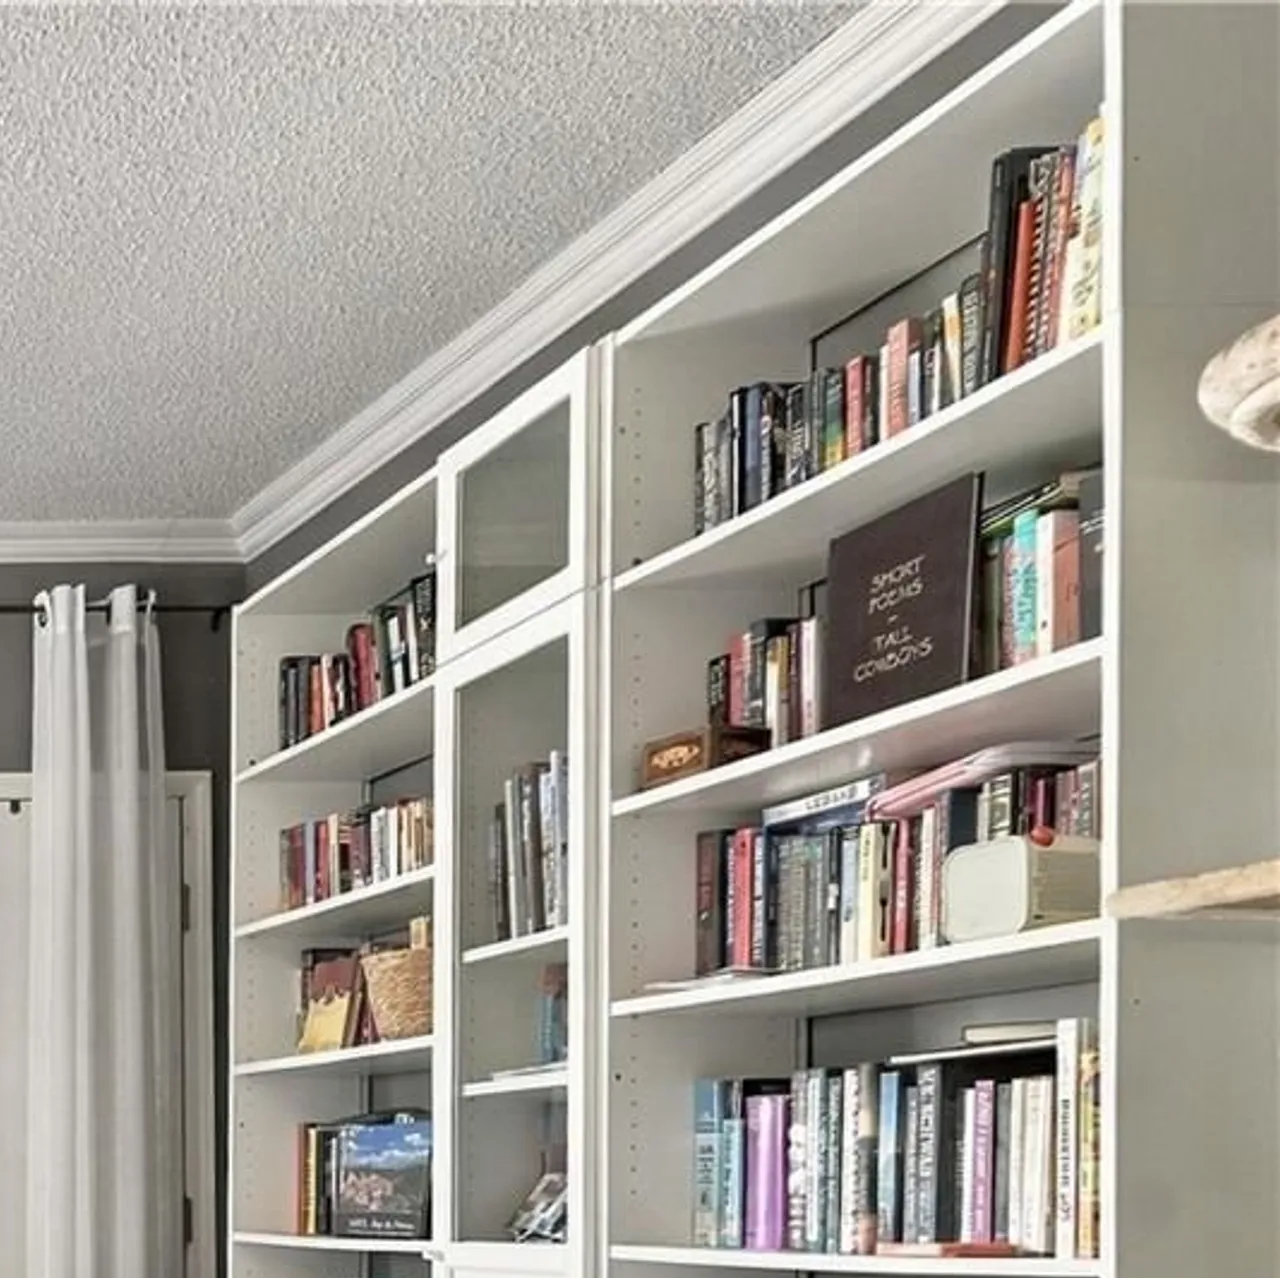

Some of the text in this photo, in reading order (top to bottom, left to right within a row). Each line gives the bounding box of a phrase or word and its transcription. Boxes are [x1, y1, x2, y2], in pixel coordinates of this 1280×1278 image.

[870, 553, 927, 594] SHORT
[868, 577, 924, 615] POEMS
[873, 626, 914, 652] TALL
[853, 636, 934, 682] COWBOYS
